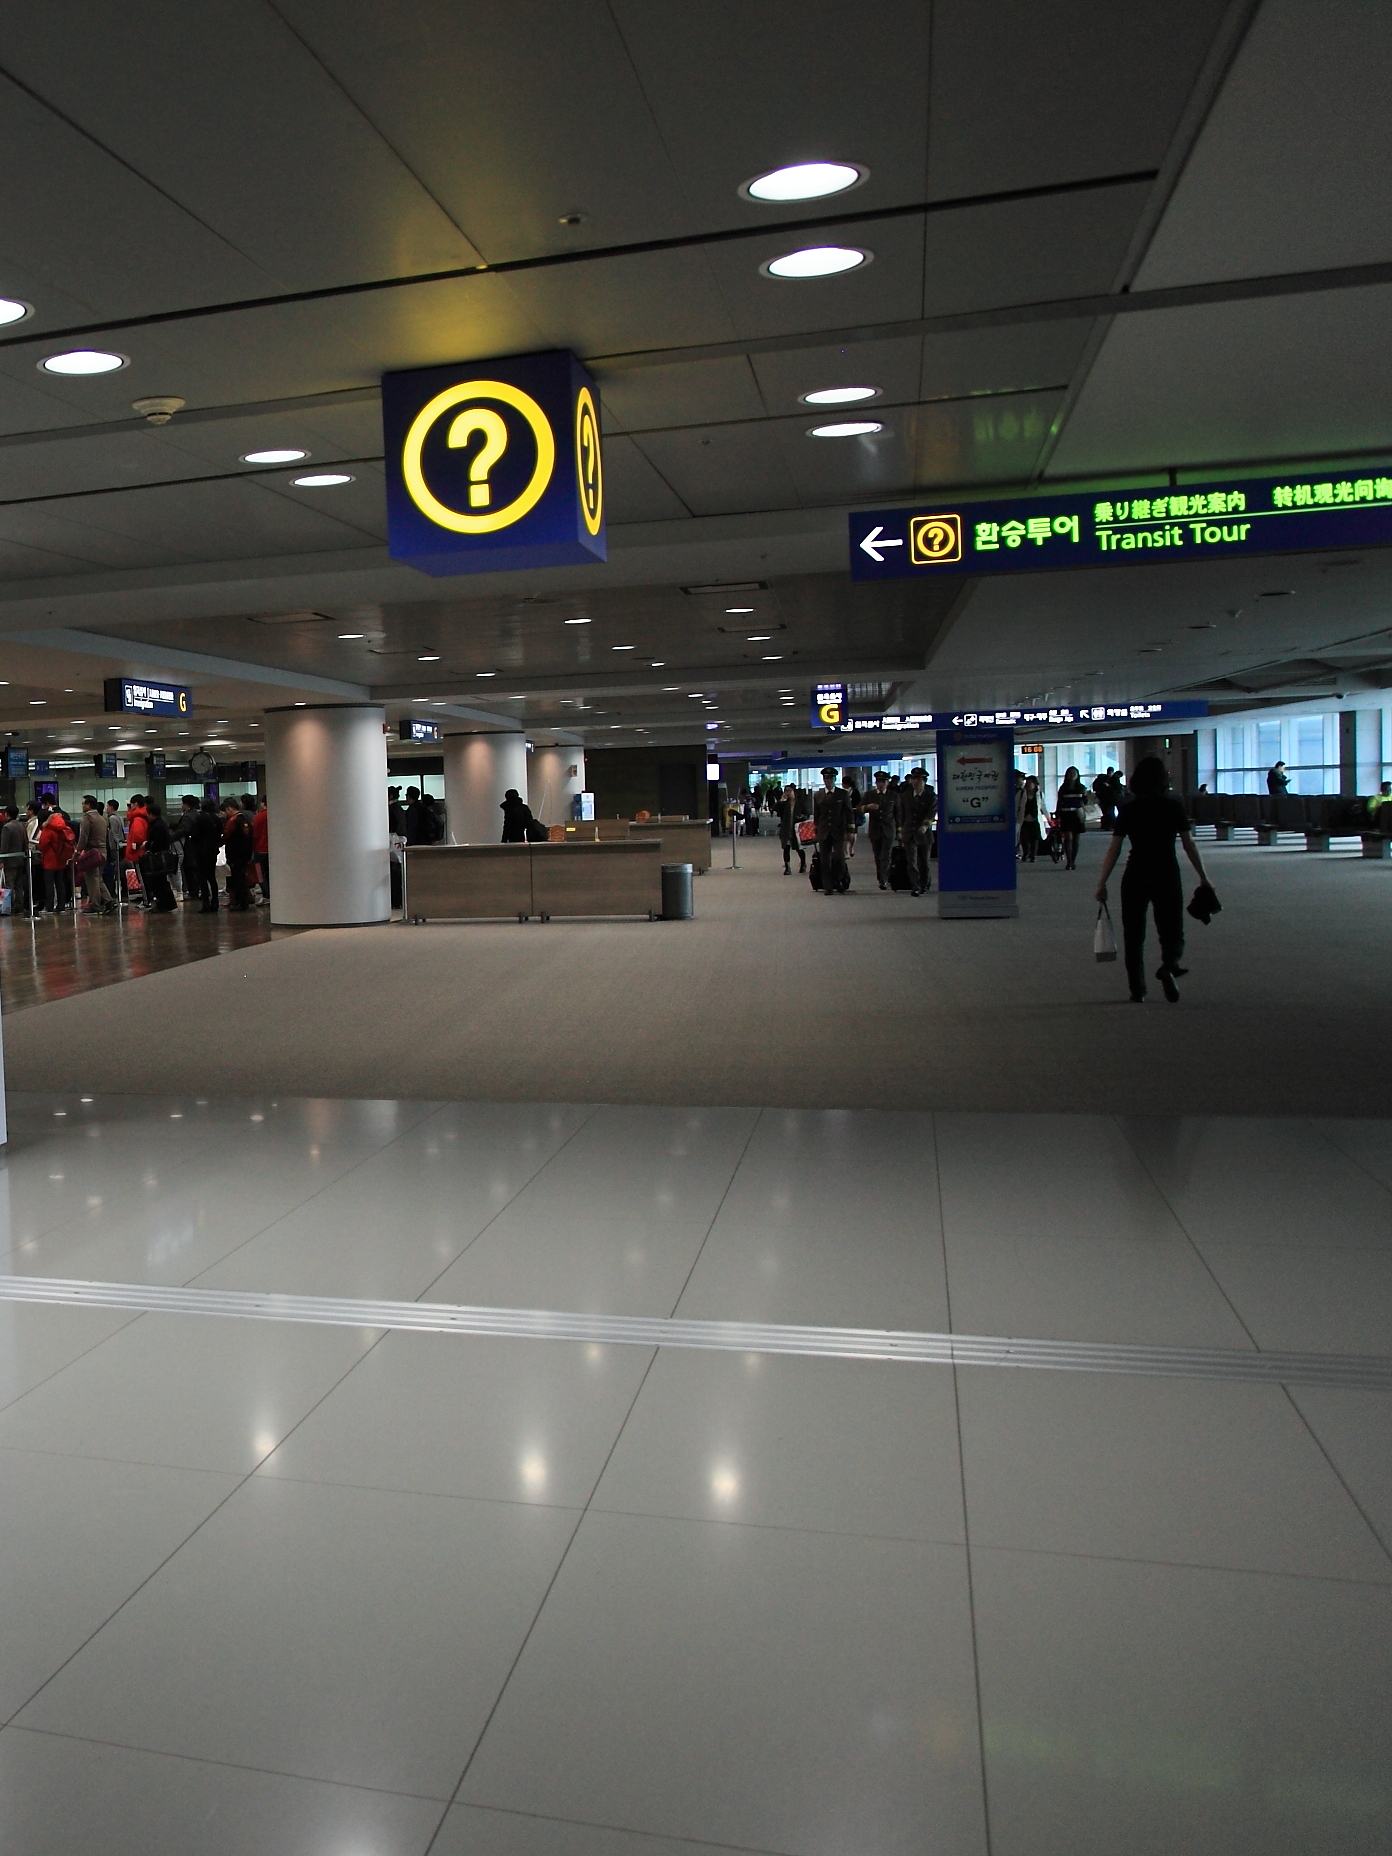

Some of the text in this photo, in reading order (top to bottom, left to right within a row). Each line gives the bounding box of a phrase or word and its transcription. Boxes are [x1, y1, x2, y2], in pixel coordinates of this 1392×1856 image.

[1094, 492, 1246, 523] 乗り継ぎ観光案内
[974, 514, 1080, 551] 환승투어
[1095, 520, 1252, 552] Transit Tour
[179, 692, 187, 712] G
[820, 704, 841, 723] G
